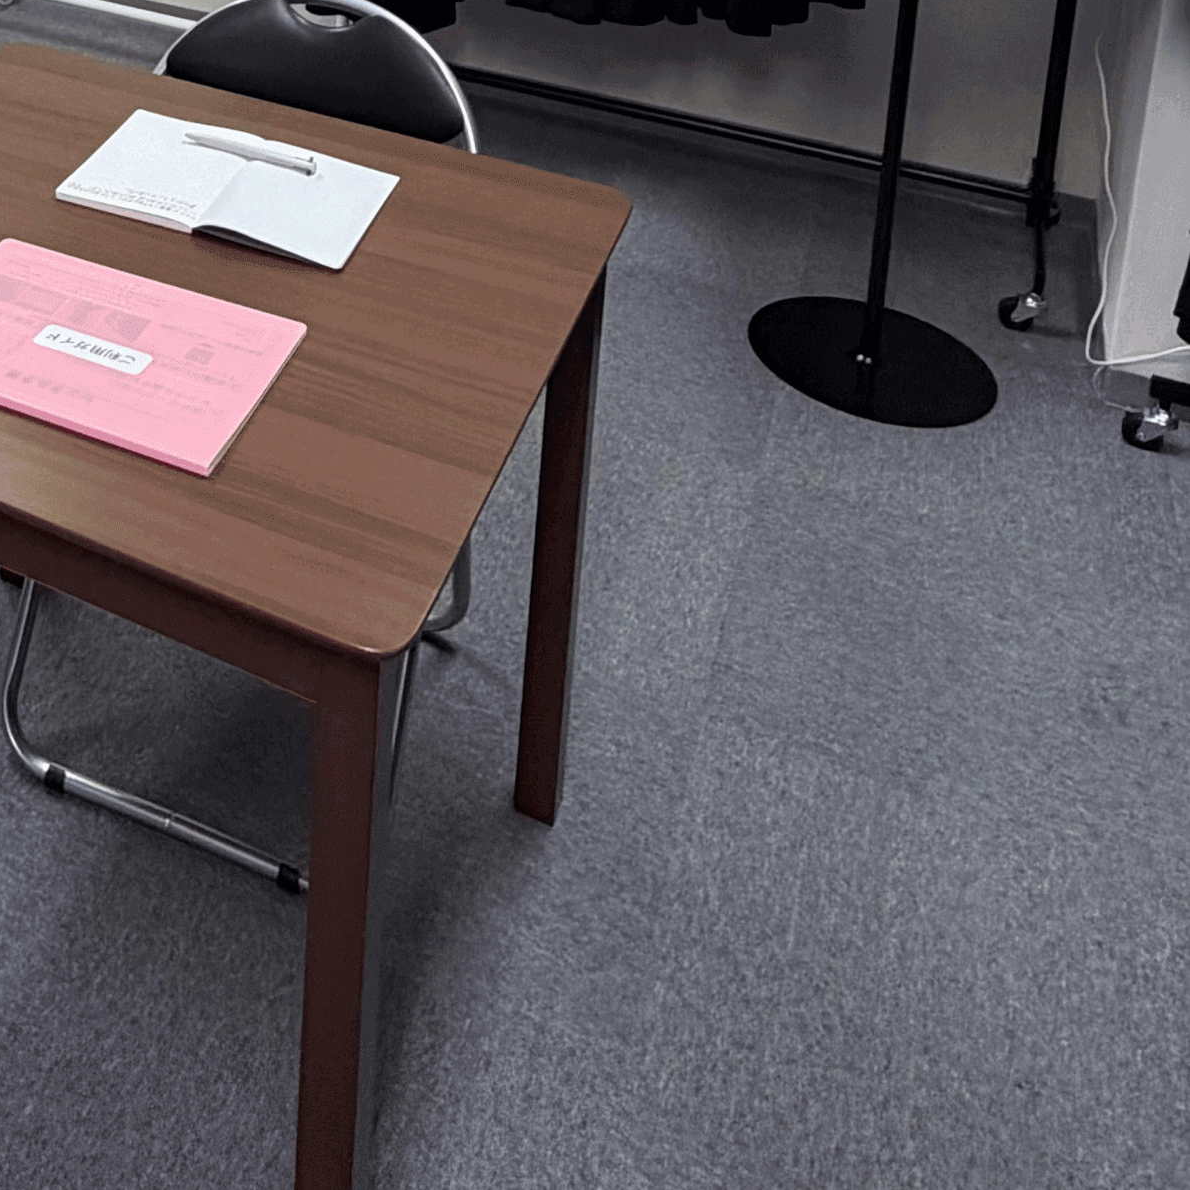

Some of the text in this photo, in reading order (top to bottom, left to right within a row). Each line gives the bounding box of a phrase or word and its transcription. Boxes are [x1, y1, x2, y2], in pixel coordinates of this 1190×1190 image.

[45, 333, 136, 365] ご利用ガイド
